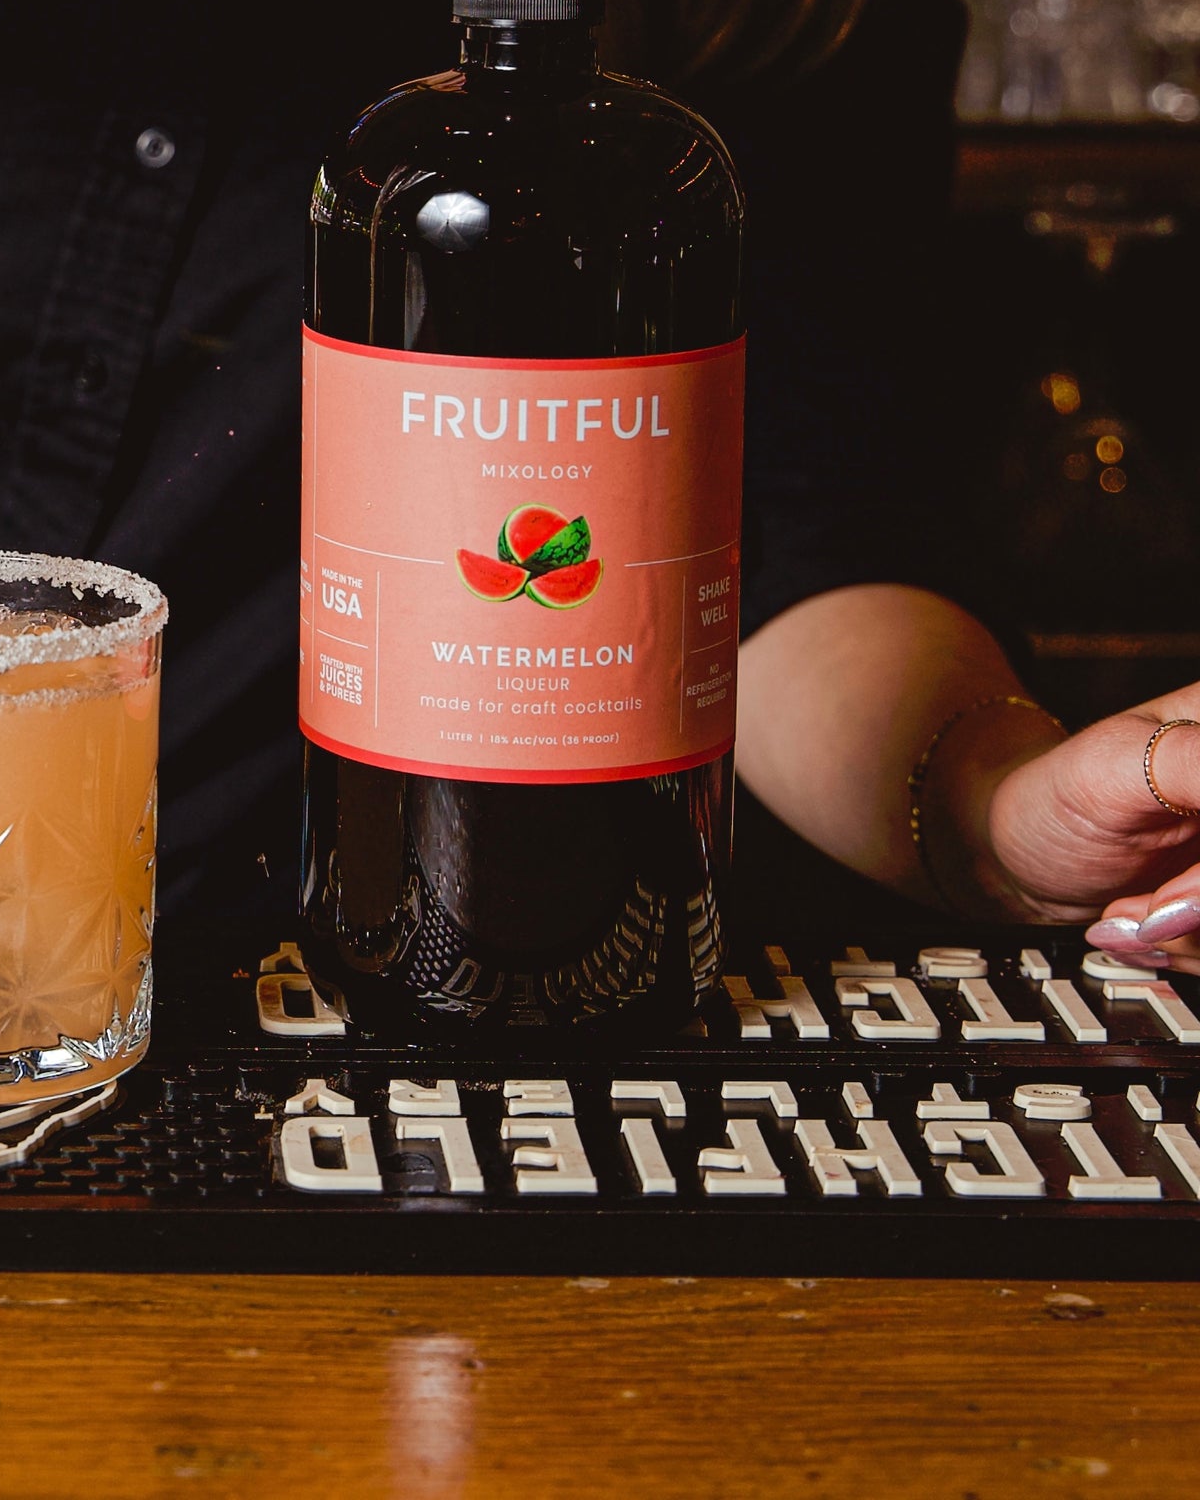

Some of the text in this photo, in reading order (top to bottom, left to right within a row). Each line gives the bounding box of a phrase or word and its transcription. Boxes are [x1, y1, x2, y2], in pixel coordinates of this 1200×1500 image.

[402, 391, 670, 442] FRUITFUL
[481, 463, 593, 480] MIXOLOGY
[321, 566, 339, 583] MADE
[347, 575, 363, 589] THE
[698, 576, 731, 602] SHAKE
[322, 582, 363, 620] USA
[701, 603, 728, 627] WELL
[319, 653, 344, 670] CRAFTED
[344, 662, 363, 675] WITH
[431, 641, 634, 668] WATERMELON
[319, 664, 363, 692] JUICES
[709, 663, 720, 676] NO
[319, 680, 363, 706] & PUREES
[496, 676, 570, 693] LIQUEUR
[686, 671, 732, 697] REFRIGERATION
[420, 695, 643, 715] made for craft cocktails
[696, 688, 727, 708] REQUIRED
[447, 731, 473, 743] LITER
[490, 734, 509, 745] 18%
[512, 734, 558, 747] ALC/VOL
[562, 734, 580, 747] (36
[582, 732, 620, 745] PROOF)
[285, 1078, 1200, 1122] ISTILLERY
